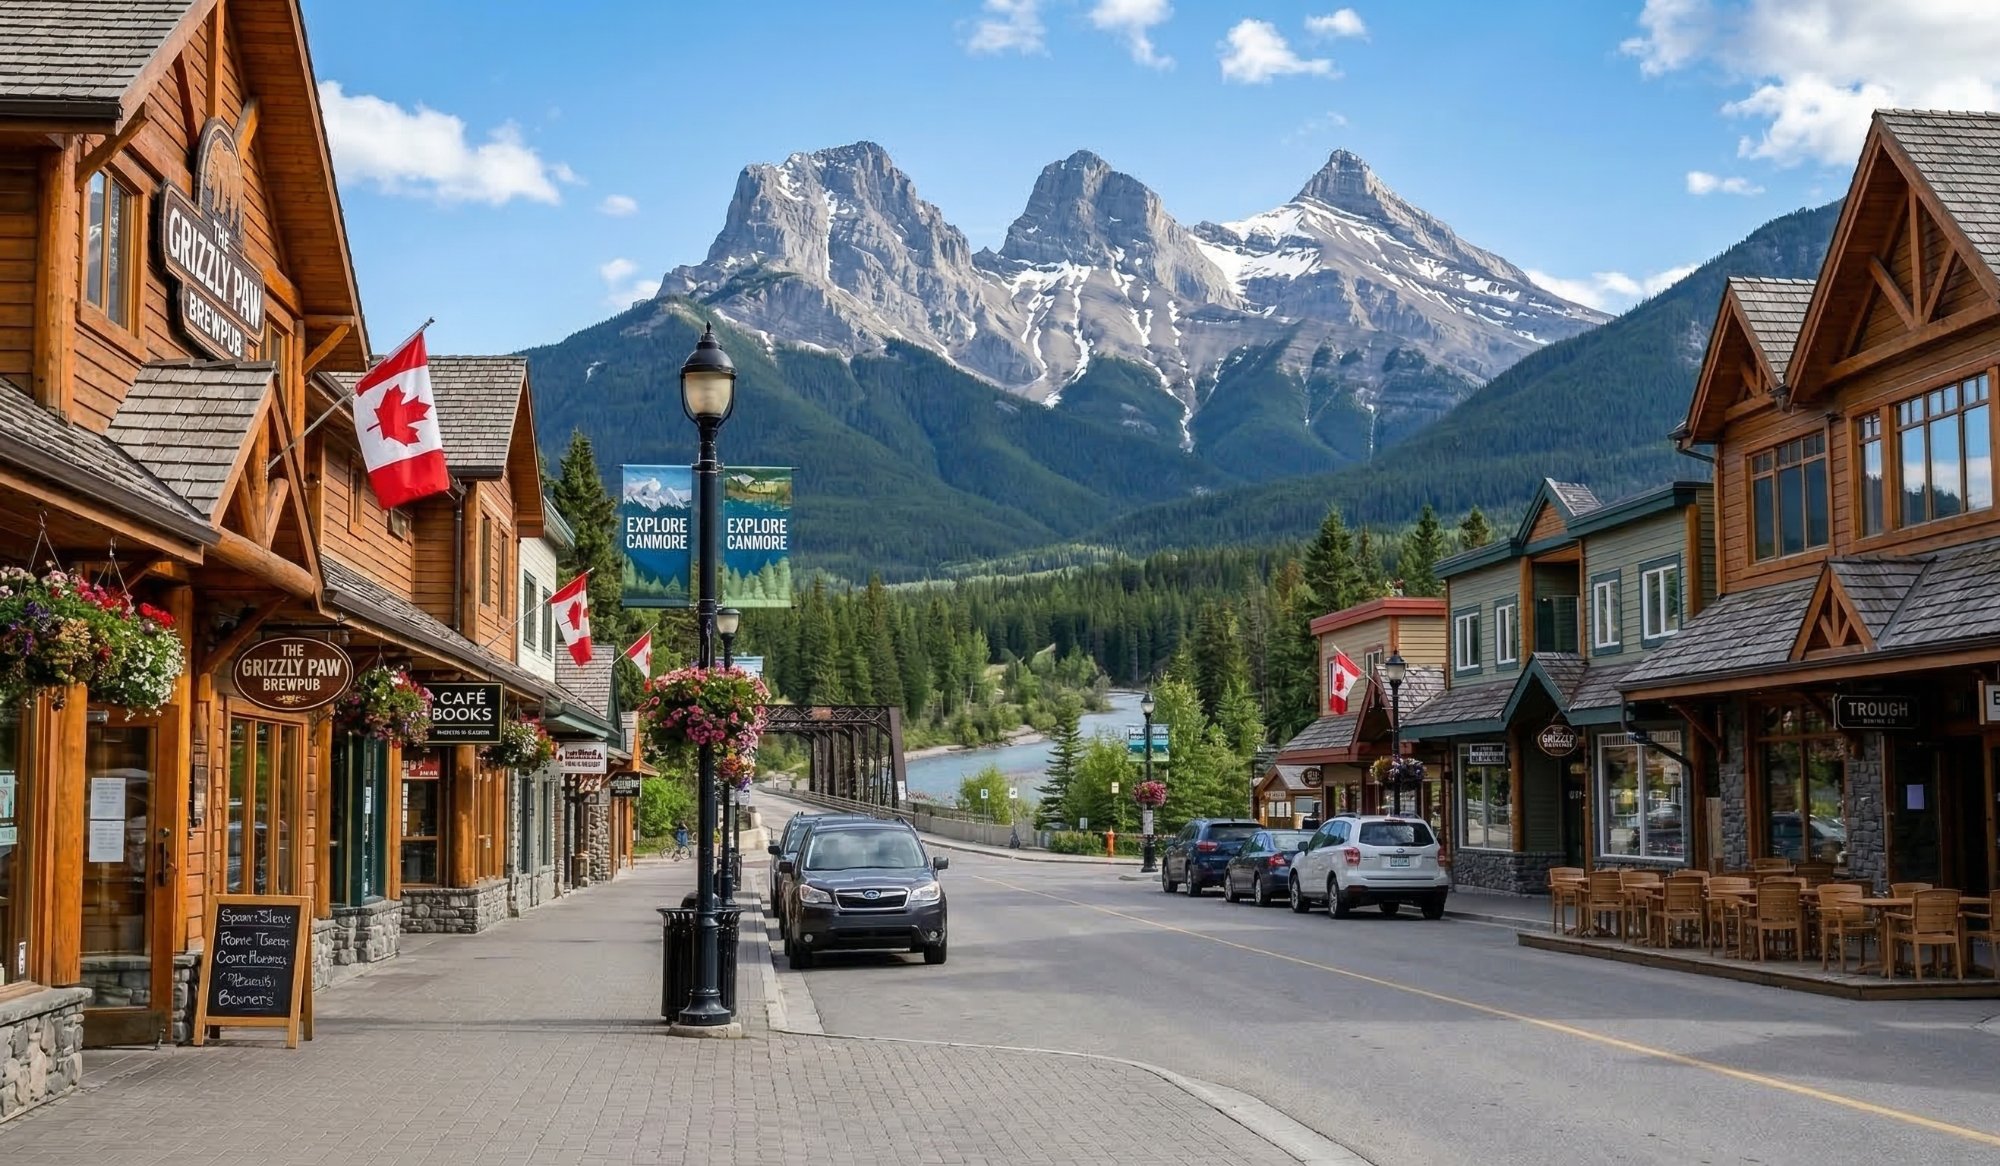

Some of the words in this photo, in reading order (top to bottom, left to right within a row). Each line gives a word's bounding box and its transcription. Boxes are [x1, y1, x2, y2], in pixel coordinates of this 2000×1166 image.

[213, 219, 229, 253] THE
[169, 207, 232, 303] GRIZZLY
[233, 265, 262, 329] PAW
[189, 291, 243, 358] BREWPUB
[627, 517, 687, 533] EXPLORE
[727, 518, 788, 534] EXPLORE
[626, 534, 688, 549] CANMORE
[727, 535, 788, 550] CANMORE
[281, 644, 304, 657] THE
[242, 658, 303, 677] GRIZZLY
[308, 658, 342, 677] PAW
[263, 678, 321, 691] BREWPUB
[440, 688, 486, 705] CAFÉ
[432, 707, 492, 721] BOOKS
[1848, 702, 1908, 717] TROUGH
